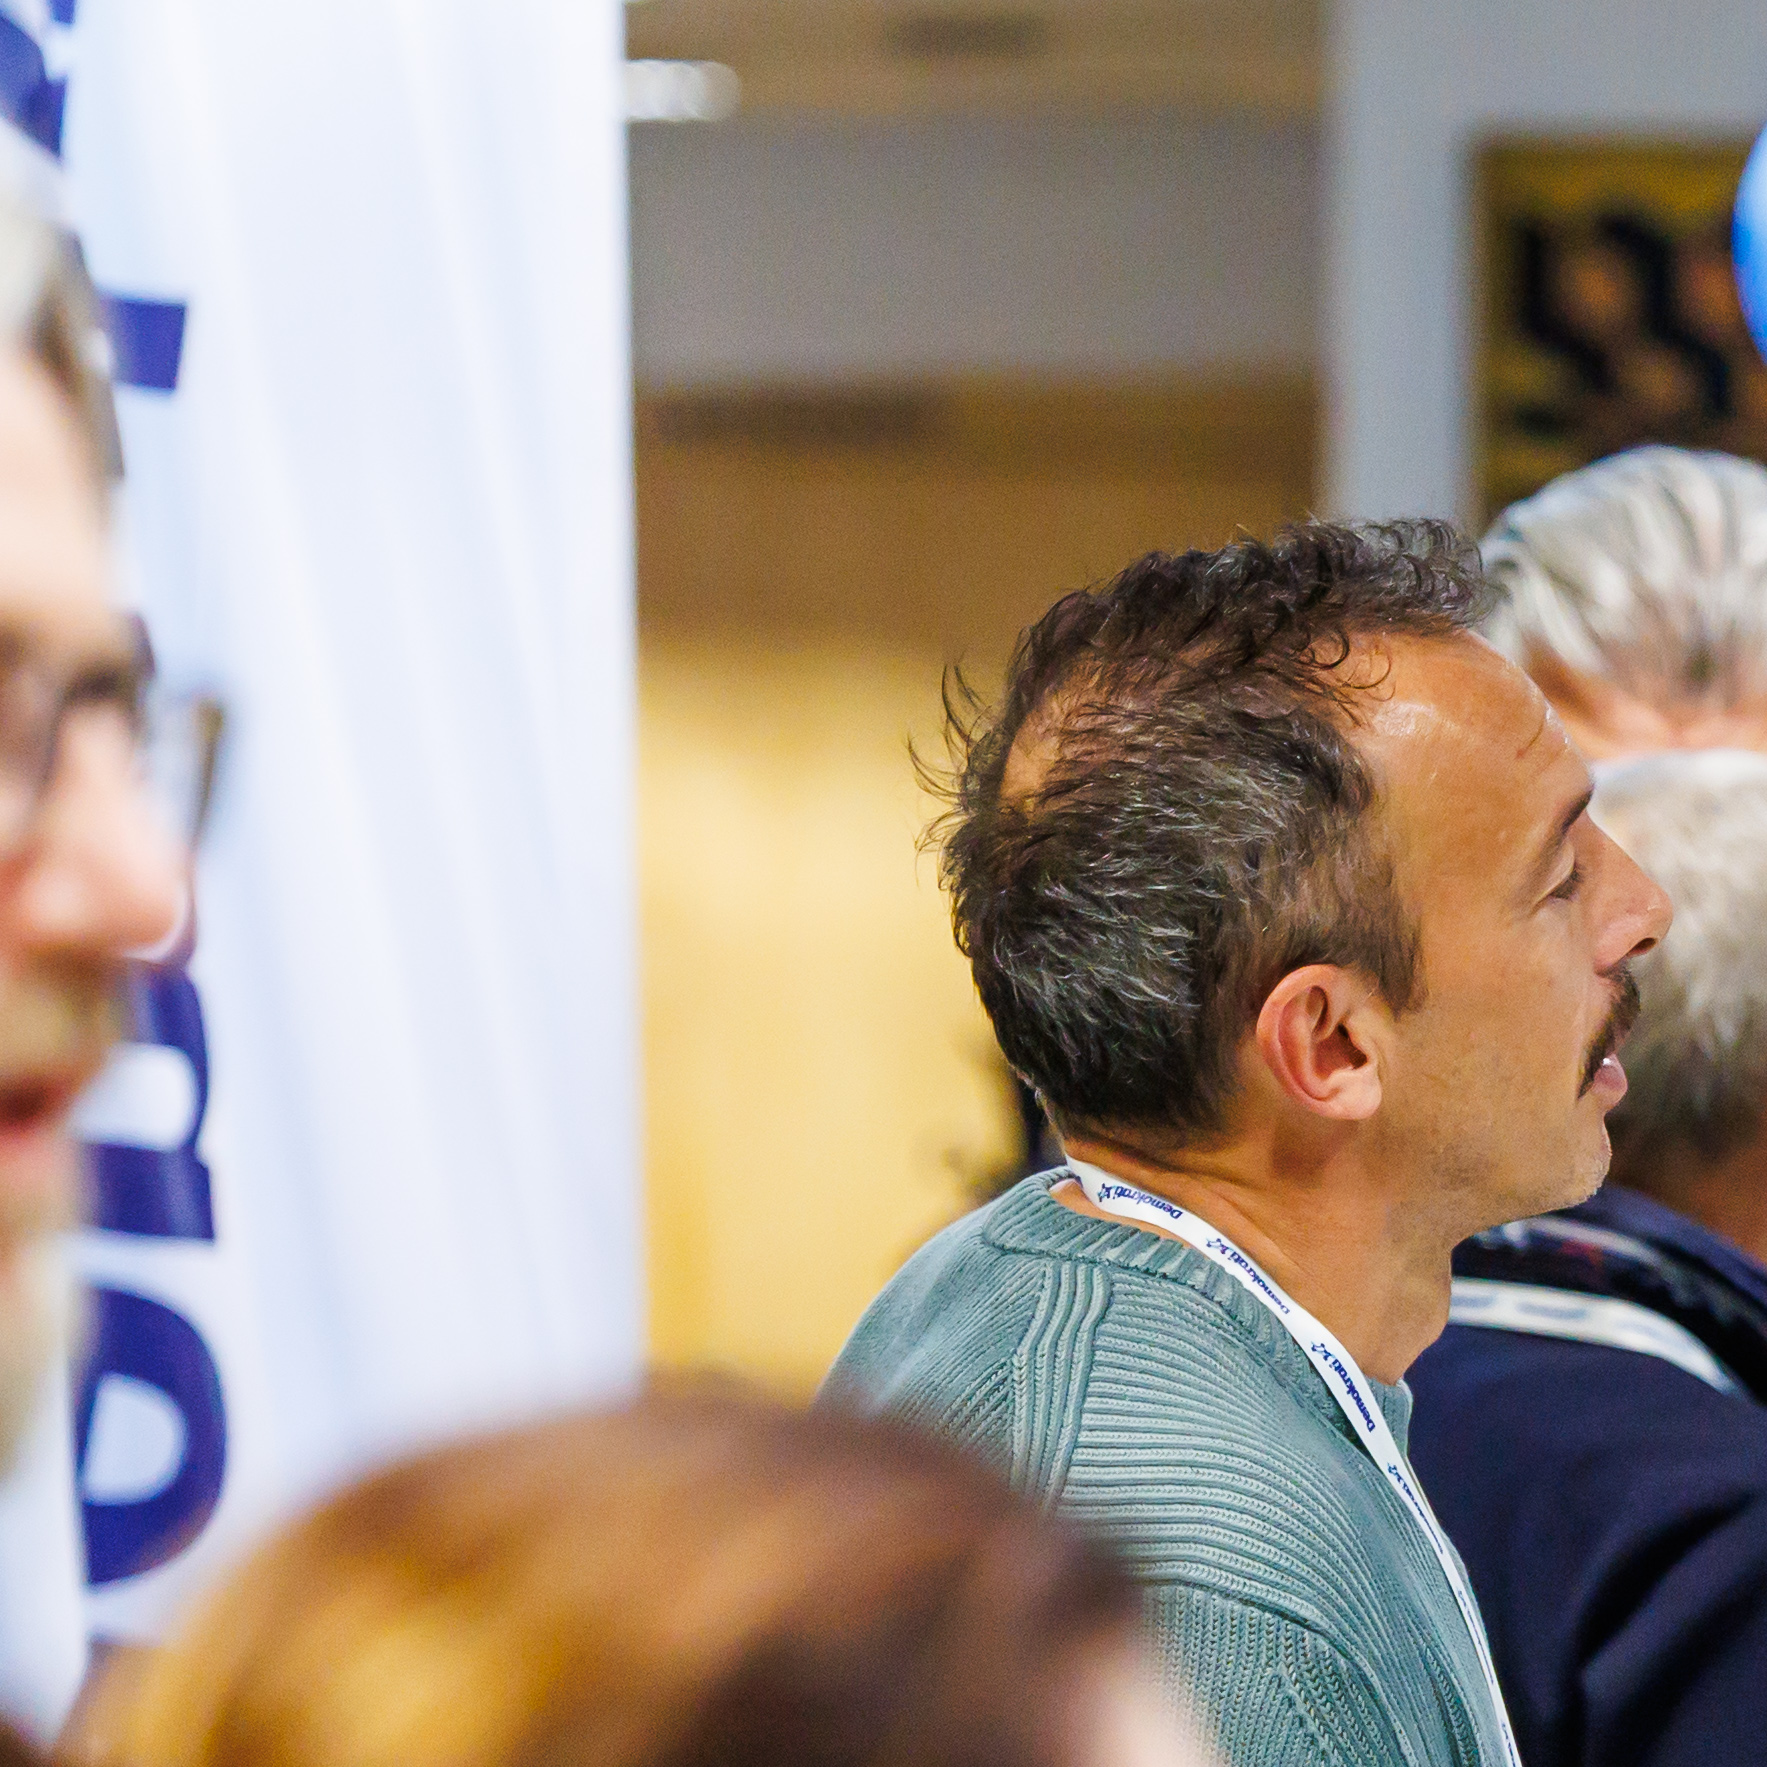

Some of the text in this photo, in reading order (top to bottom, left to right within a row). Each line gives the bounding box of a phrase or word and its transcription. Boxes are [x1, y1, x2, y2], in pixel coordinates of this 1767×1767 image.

[1112, 1184, 1184, 1220] Demokrati
[1227, 1250, 1291, 1315] Demokrati
[1329, 1358, 1376, 1434] Demokrati
